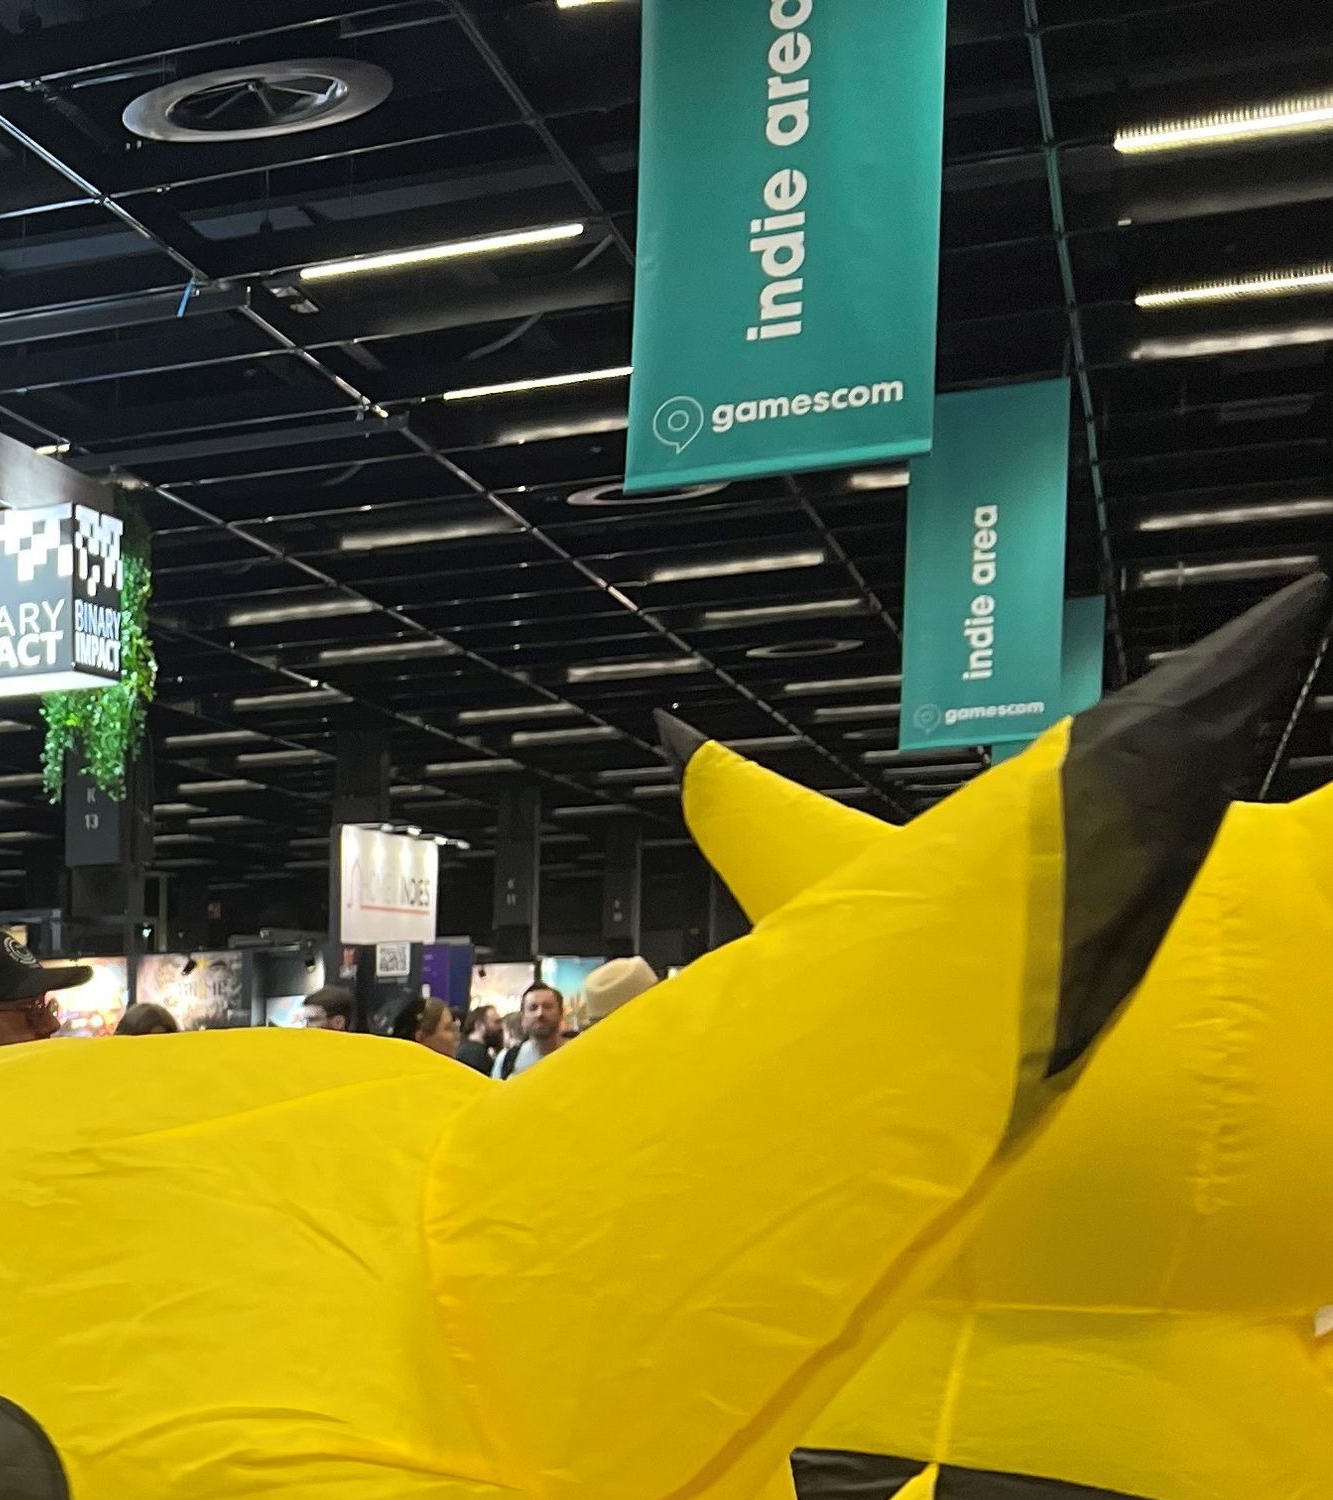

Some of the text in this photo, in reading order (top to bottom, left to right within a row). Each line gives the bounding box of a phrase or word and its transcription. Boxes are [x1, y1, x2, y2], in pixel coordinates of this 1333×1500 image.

[746, 0, 815, 342] indie area
[711, 379, 905, 434] gamescom
[962, 504, 999, 681] indie area
[74, 599, 121, 641] BINARY
[74, 632, 121, 672] IMPACT
[944, 698, 1045, 725] gamescom
[86, 787, 96, 803] K
[85, 813, 99, 831] 13
